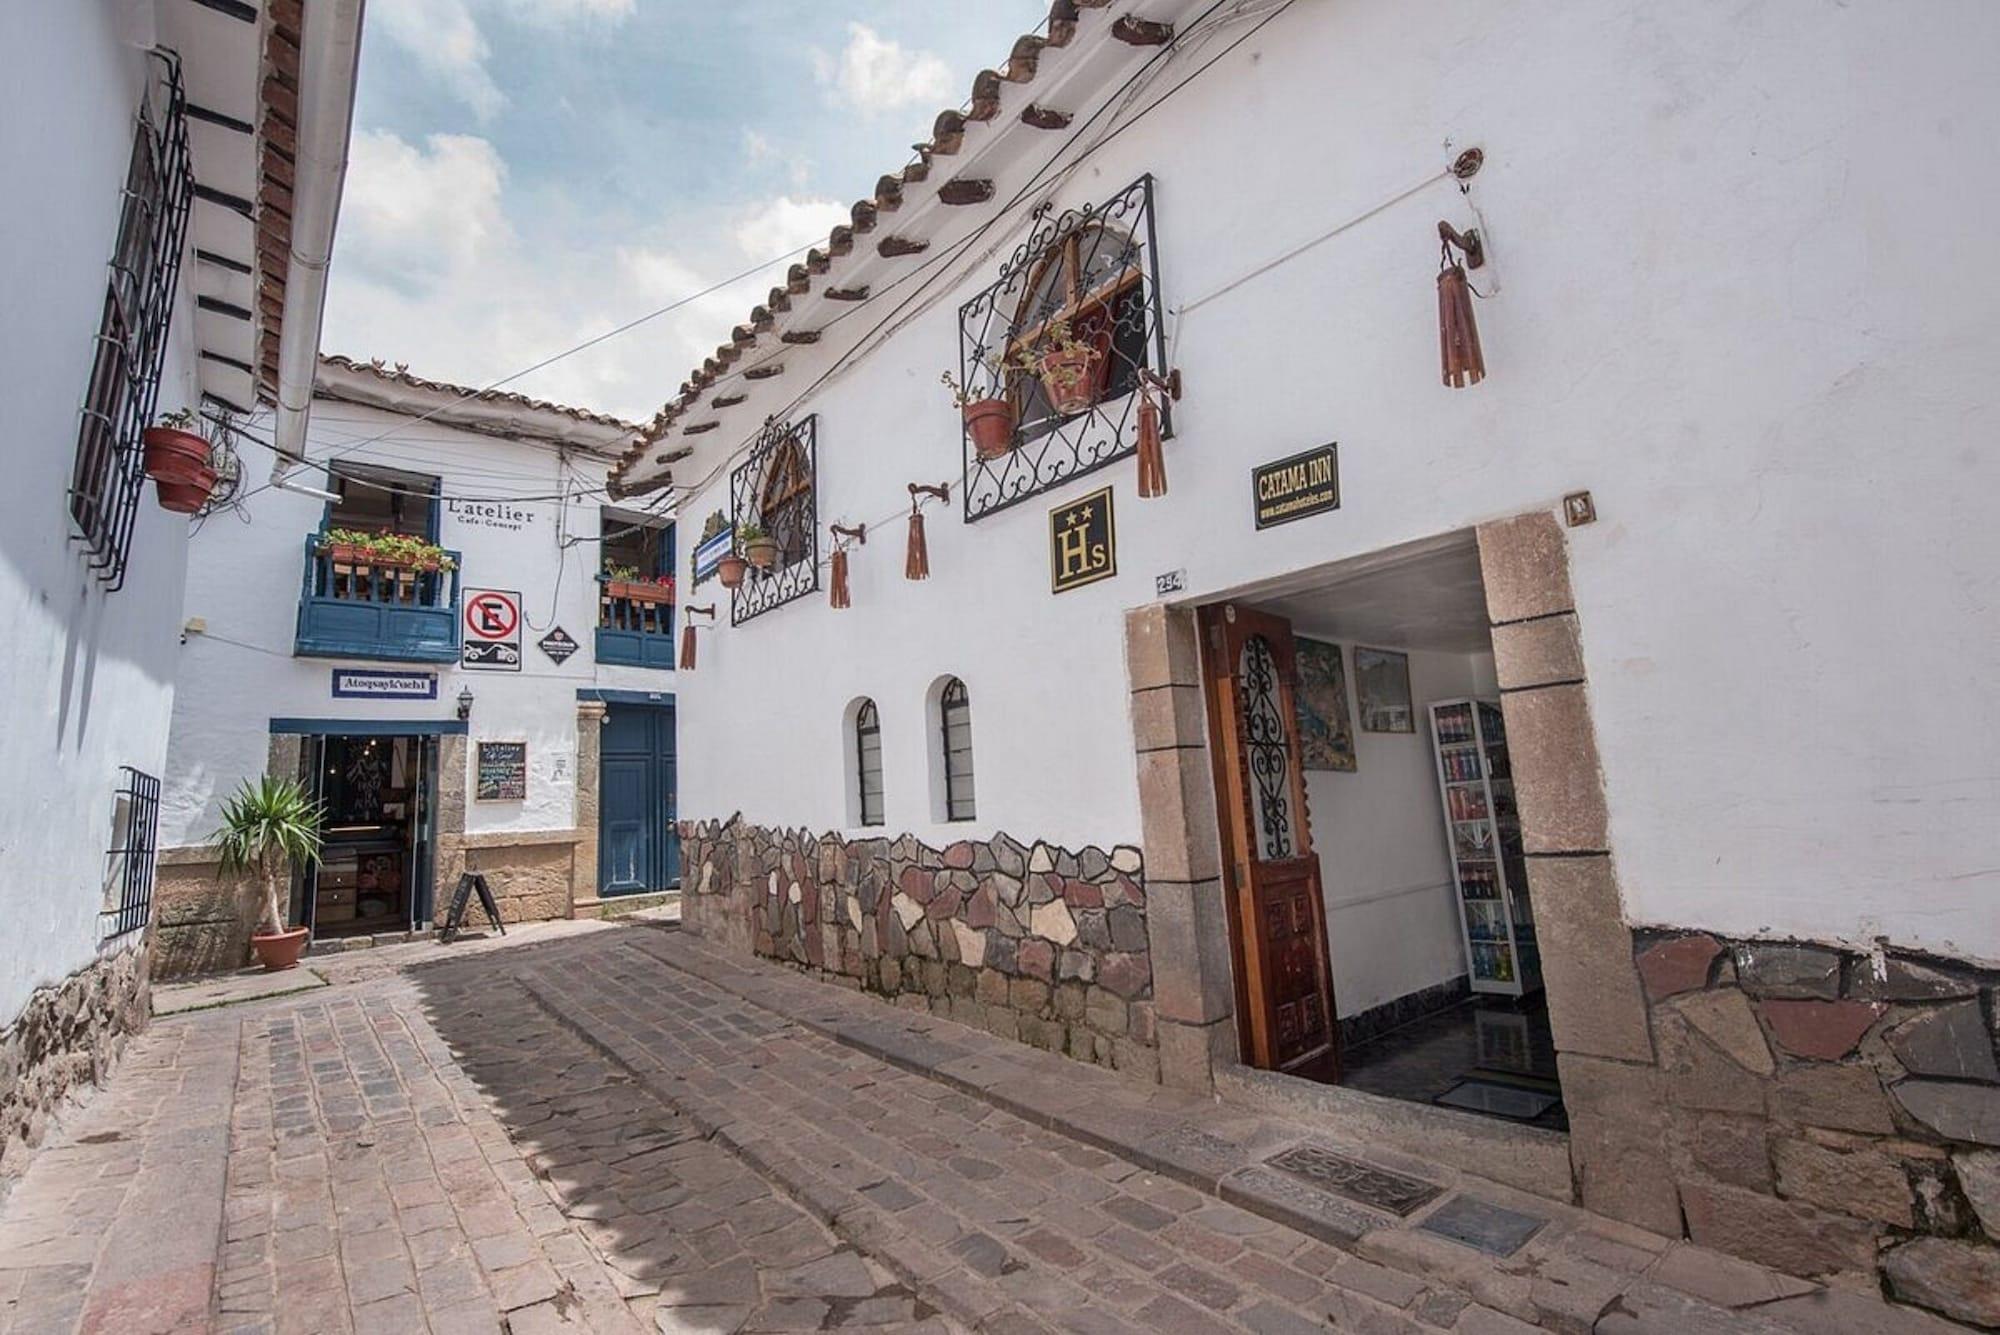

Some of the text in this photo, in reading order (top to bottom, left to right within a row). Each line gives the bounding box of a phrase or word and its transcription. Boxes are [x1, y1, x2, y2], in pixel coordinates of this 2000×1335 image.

[1258, 455, 1332, 501] CATAMA INN
[481, 602, 503, 631] E
